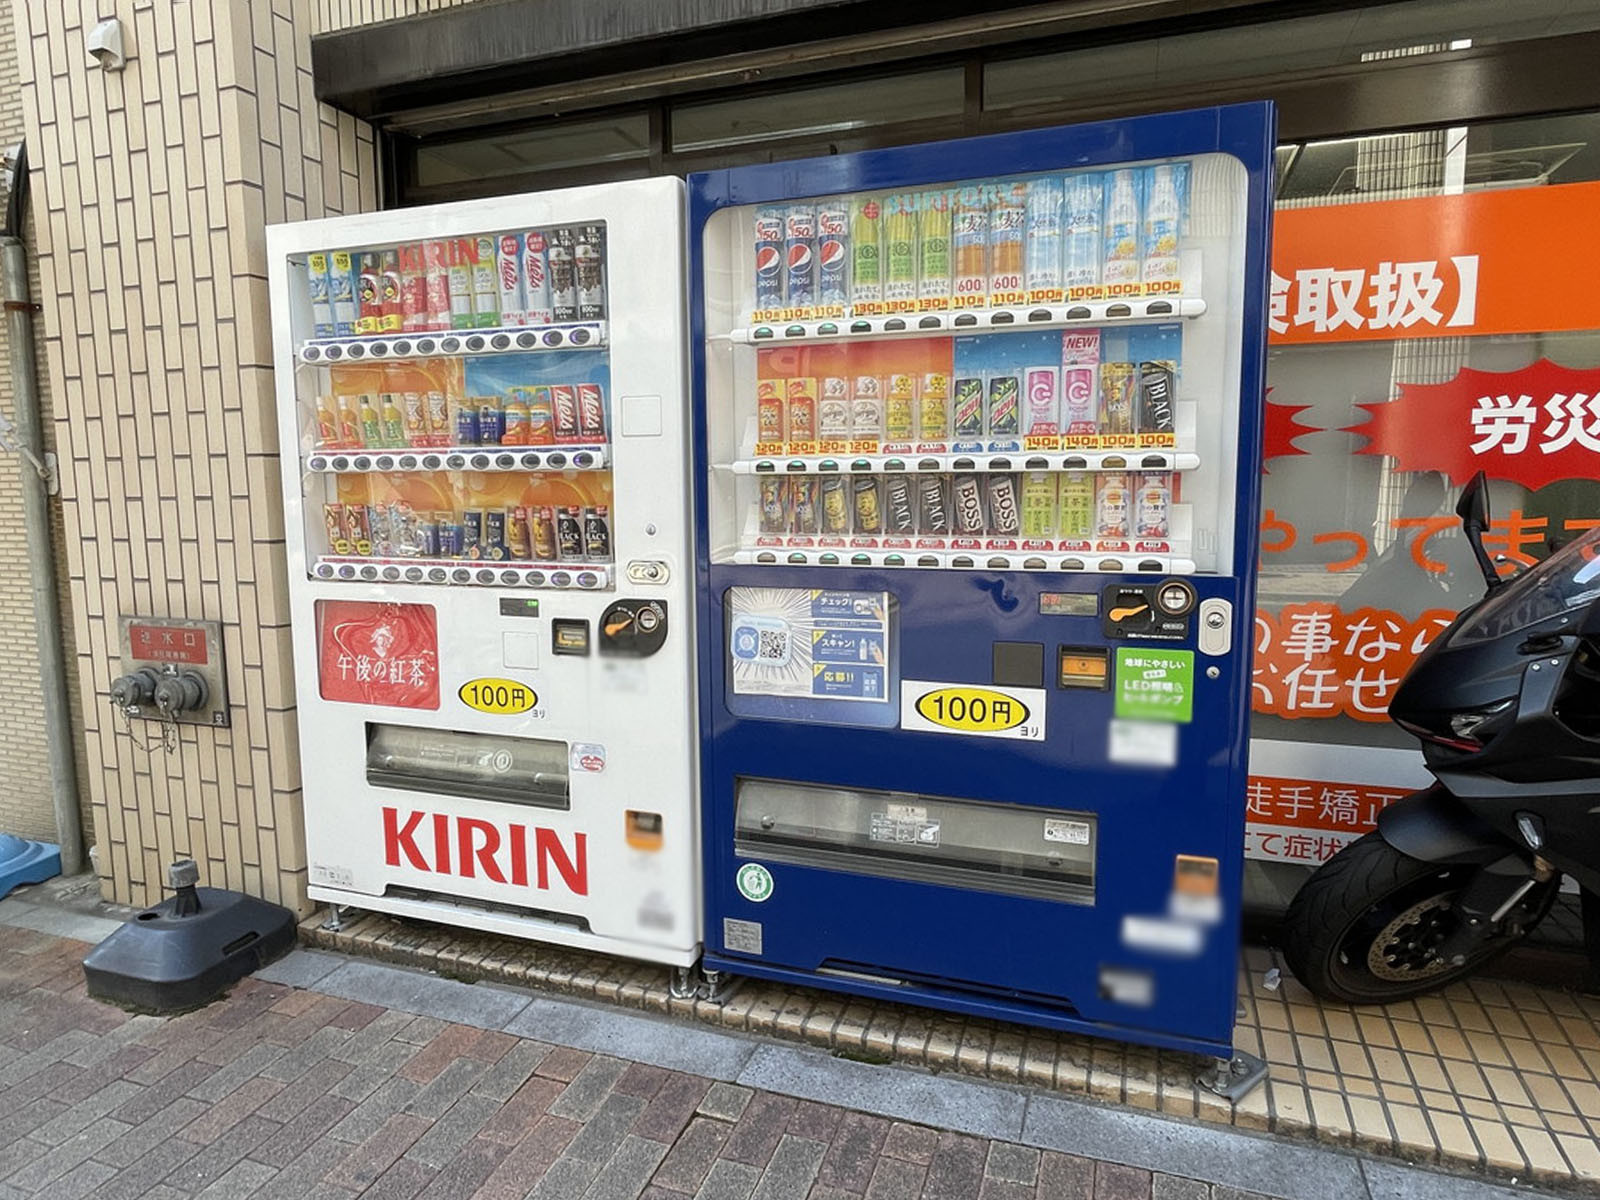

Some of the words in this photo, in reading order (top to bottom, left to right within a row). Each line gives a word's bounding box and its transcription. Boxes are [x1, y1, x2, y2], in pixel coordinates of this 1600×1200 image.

[397, 236, 480, 272] KIRIN
[503, 258, 518, 291] Mets
[528, 255, 545, 288] Mets
[1030, 290, 1063, 300] 100円
[1069, 287, 1103, 298] 100円
[1107, 284, 1141, 295] 100円
[1146, 281, 1181, 293] 100円
[1066, 336, 1098, 349] NEW!
[556, 389, 573, 430] Mets
[583, 388, 599, 428] Mets
[1150, 375, 1173, 430] BLACK
[1027, 437, 1059, 447] 140円
[1066, 437, 1098, 447] 140円
[1101, 436, 1135, 445] 100円
[1140, 435, 1174, 445] 100円
[892, 483, 913, 531] BLACK
[926, 483, 945, 531] BLACK
[961, 487, 982, 531] BOSS
[997, 486, 1018, 530] BOSS
[337, 654, 425, 688] 午後の紅茶
[1124, 657, 1186, 669] 地球にやさしい
[470, 685, 525, 708] 100円
[933, 695, 1011, 724] 100円
[532, 709, 546, 719] ヨリ
[1020, 726, 1040, 738] ヨリ
[382, 806, 588, 897] KIRIN
